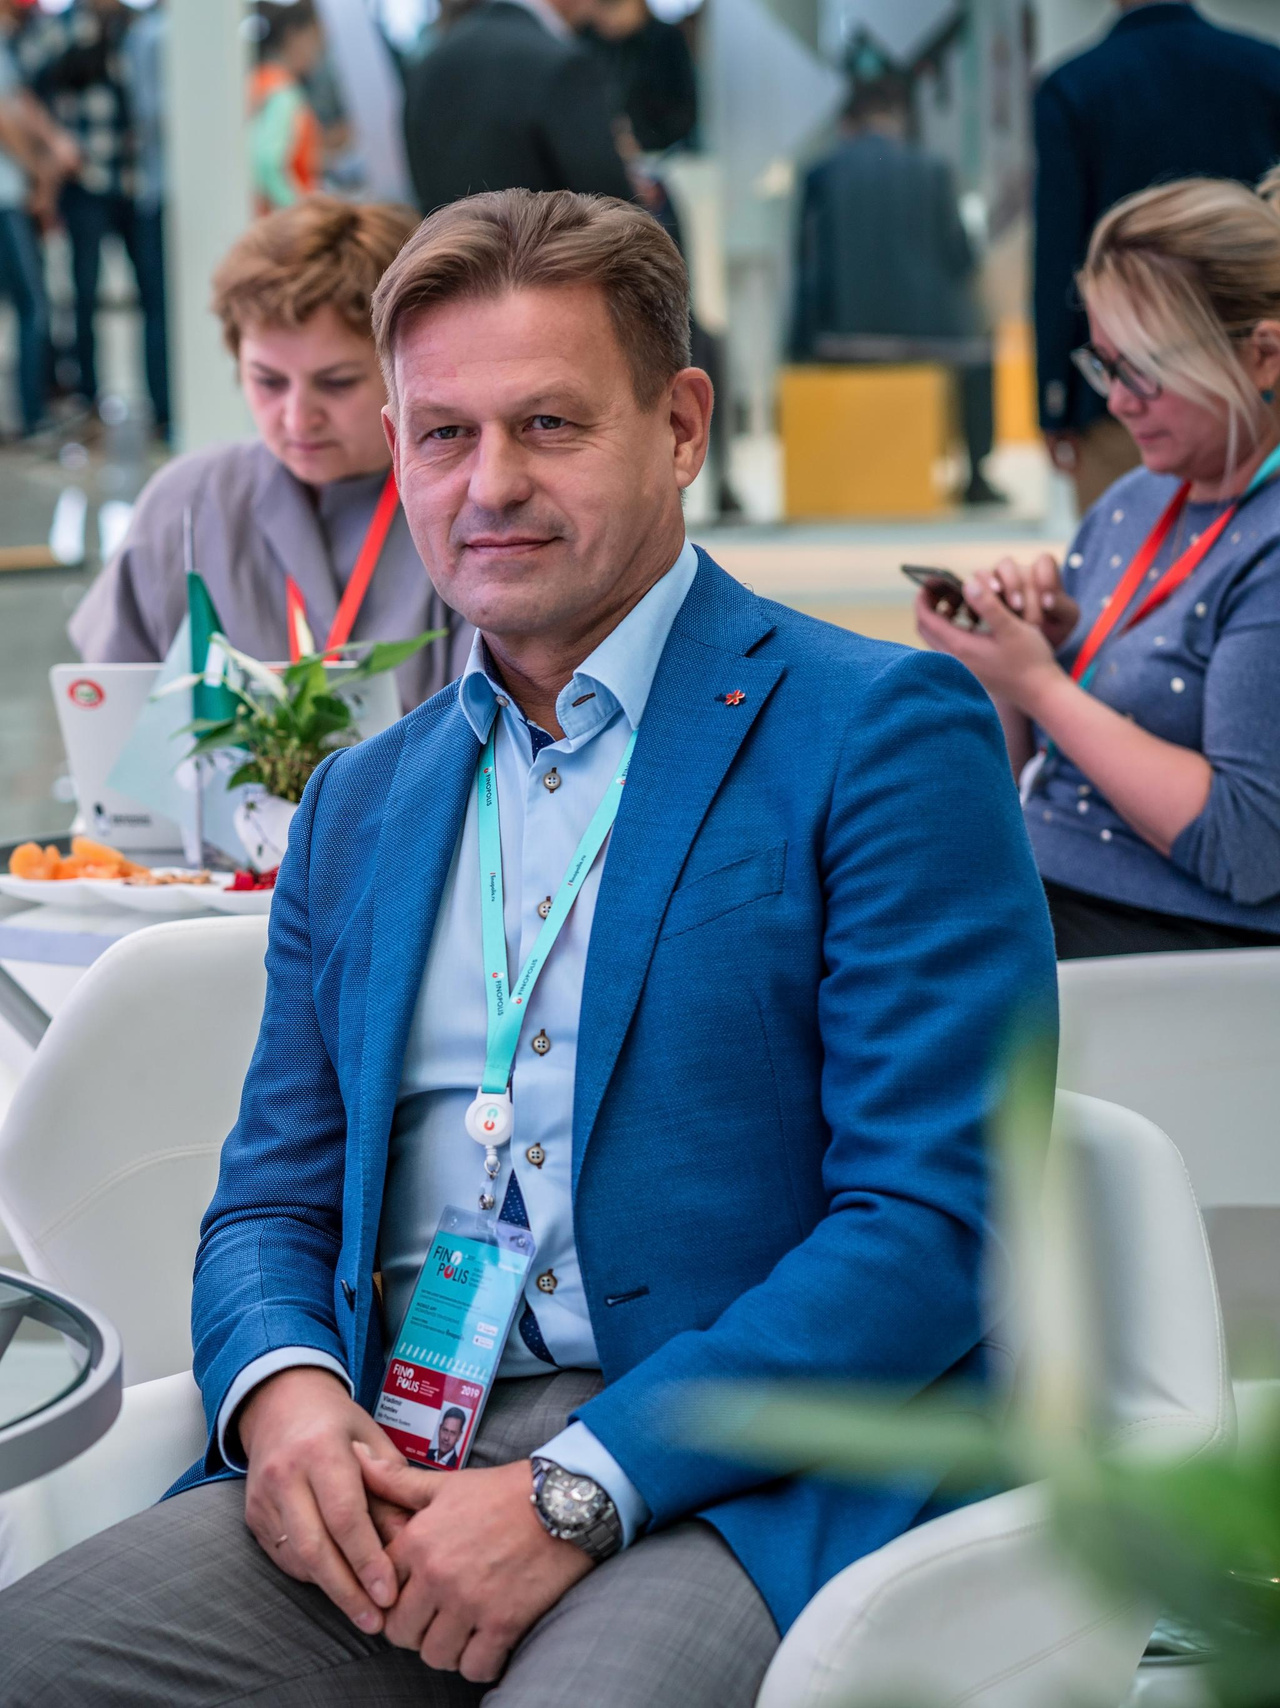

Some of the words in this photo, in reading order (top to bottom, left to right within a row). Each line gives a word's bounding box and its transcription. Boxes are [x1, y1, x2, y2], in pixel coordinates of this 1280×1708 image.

[485, 773, 493, 807] FINOPOLIS
[518, 958, 538, 995] FINOPOLIS
[495, 980, 504, 1016] FINOPOLIS
[461, 1385, 480, 1398] 2019
